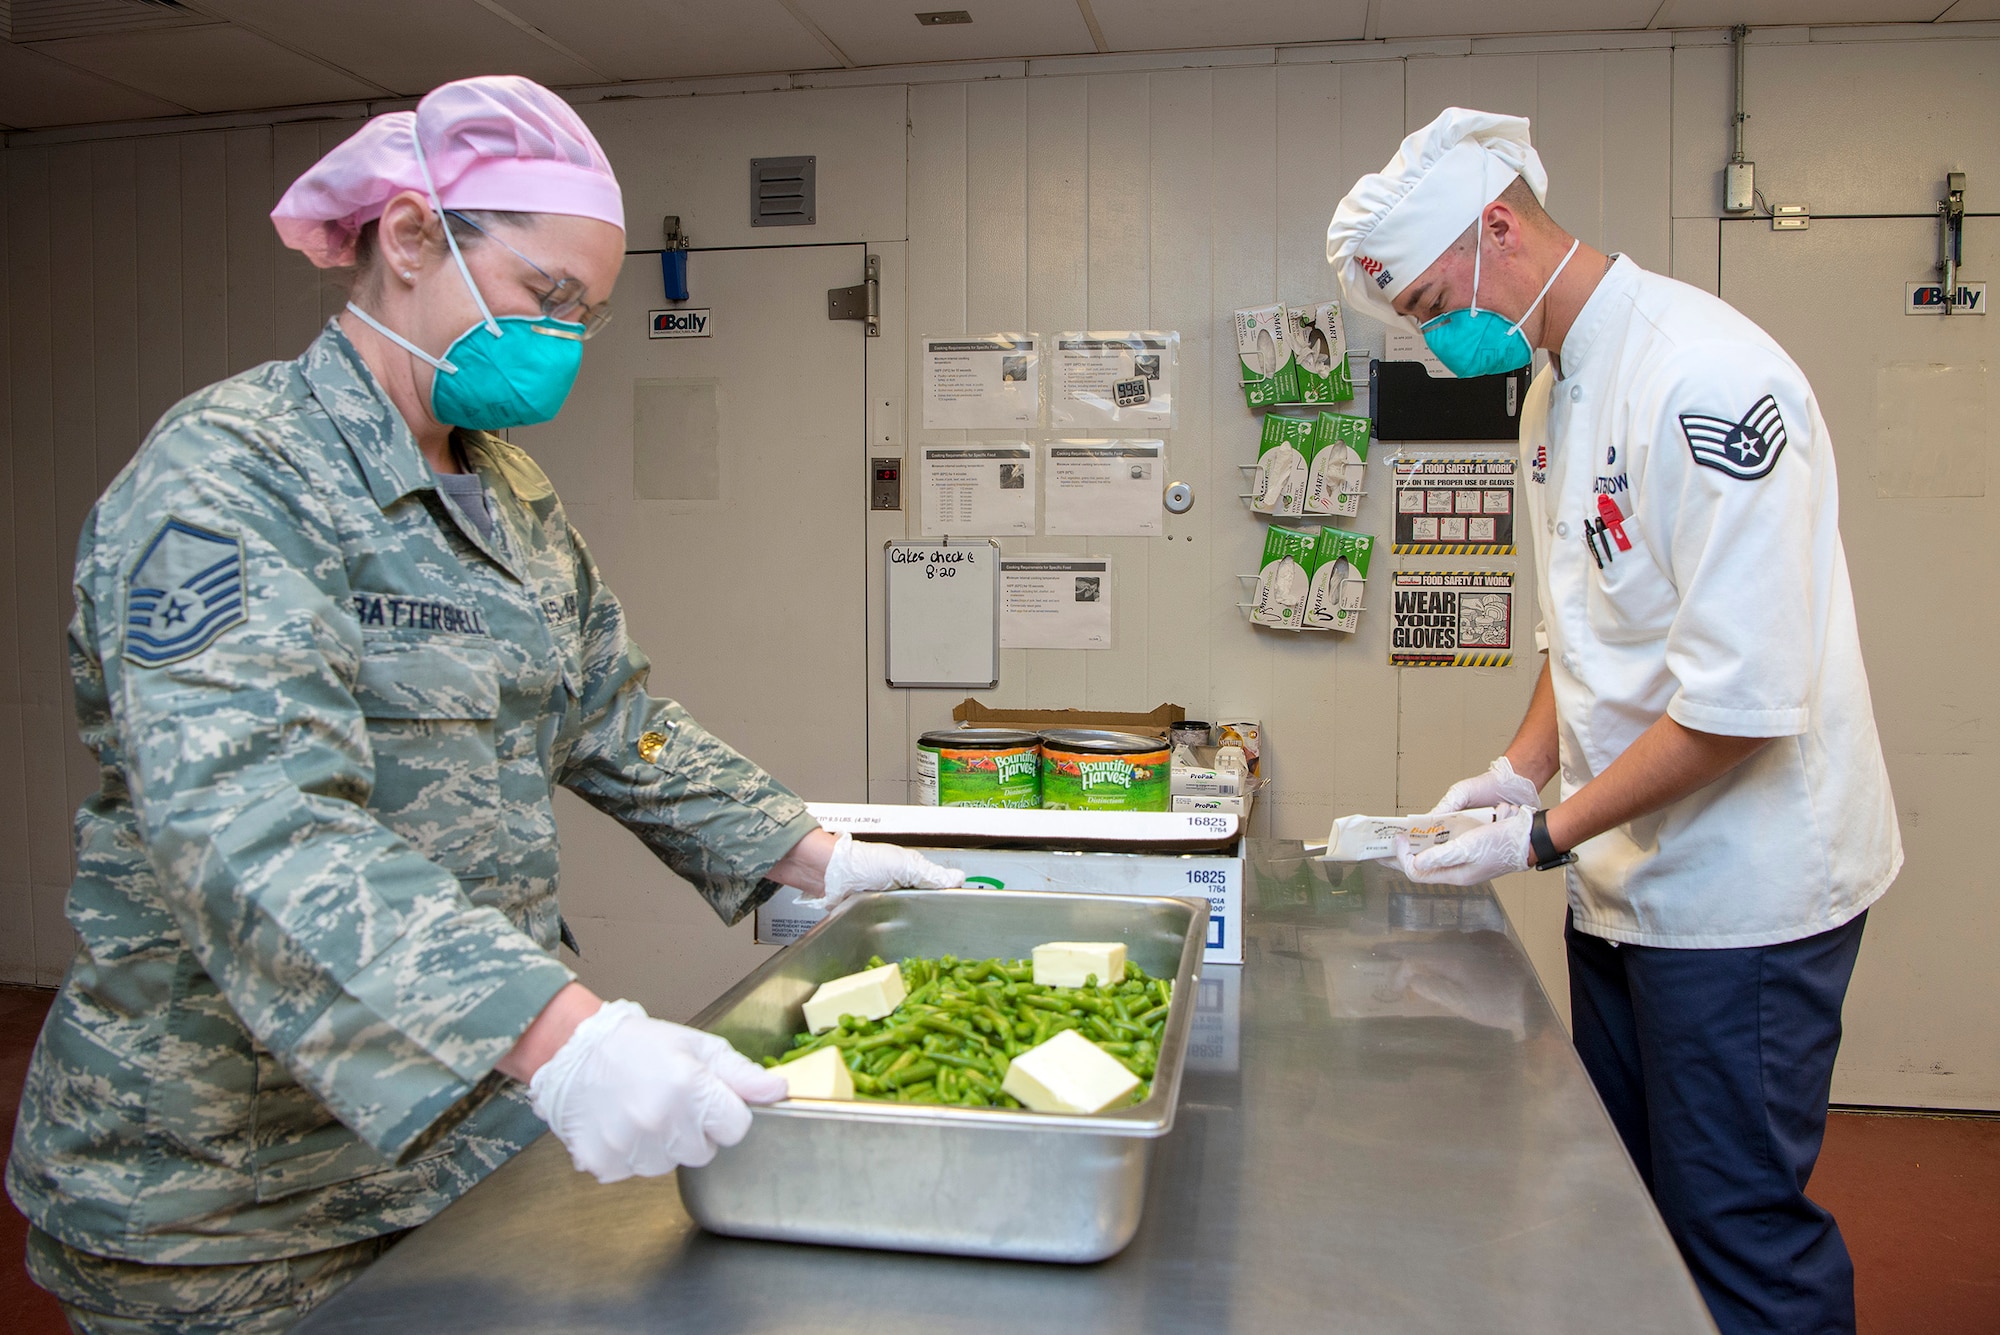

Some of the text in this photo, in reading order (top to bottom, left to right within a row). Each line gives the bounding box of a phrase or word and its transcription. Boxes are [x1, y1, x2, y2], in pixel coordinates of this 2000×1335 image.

[1930, 287, 1981, 309] Blly
[665, 313, 707, 333] Bally
[1273, 312, 1283, 341] SMART
[1327, 311, 1338, 340] SMART
[1424, 463, 1513, 474] FOOD SAFETY AT WORK
[1314, 473, 1324, 502] SMART
[891, 548, 925, 564] Cakes
[930, 551, 964, 564] check
[925, 564, 956, 579] 8:20
[1422, 576, 1510, 586] FOOD SAFETY AT WORK
[1394, 591, 1456, 614] WEAR
[1394, 614, 1456, 627] YOUR
[1393, 628, 1455, 649] GLOVES
[994, 749, 1038, 768] Bountiful
[998, 762, 1036, 785] Harvest
[1078, 759, 1135, 775] Bountiful
[1082, 770, 1132, 790] Harvest
[1087, 796, 1125, 804] Distinctions
[1187, 817, 1227, 827] 16825
[1410, 825, 1446, 834] Butter
[1186, 870, 1226, 884] 16825
[1208, 885, 1226, 893] 1764
